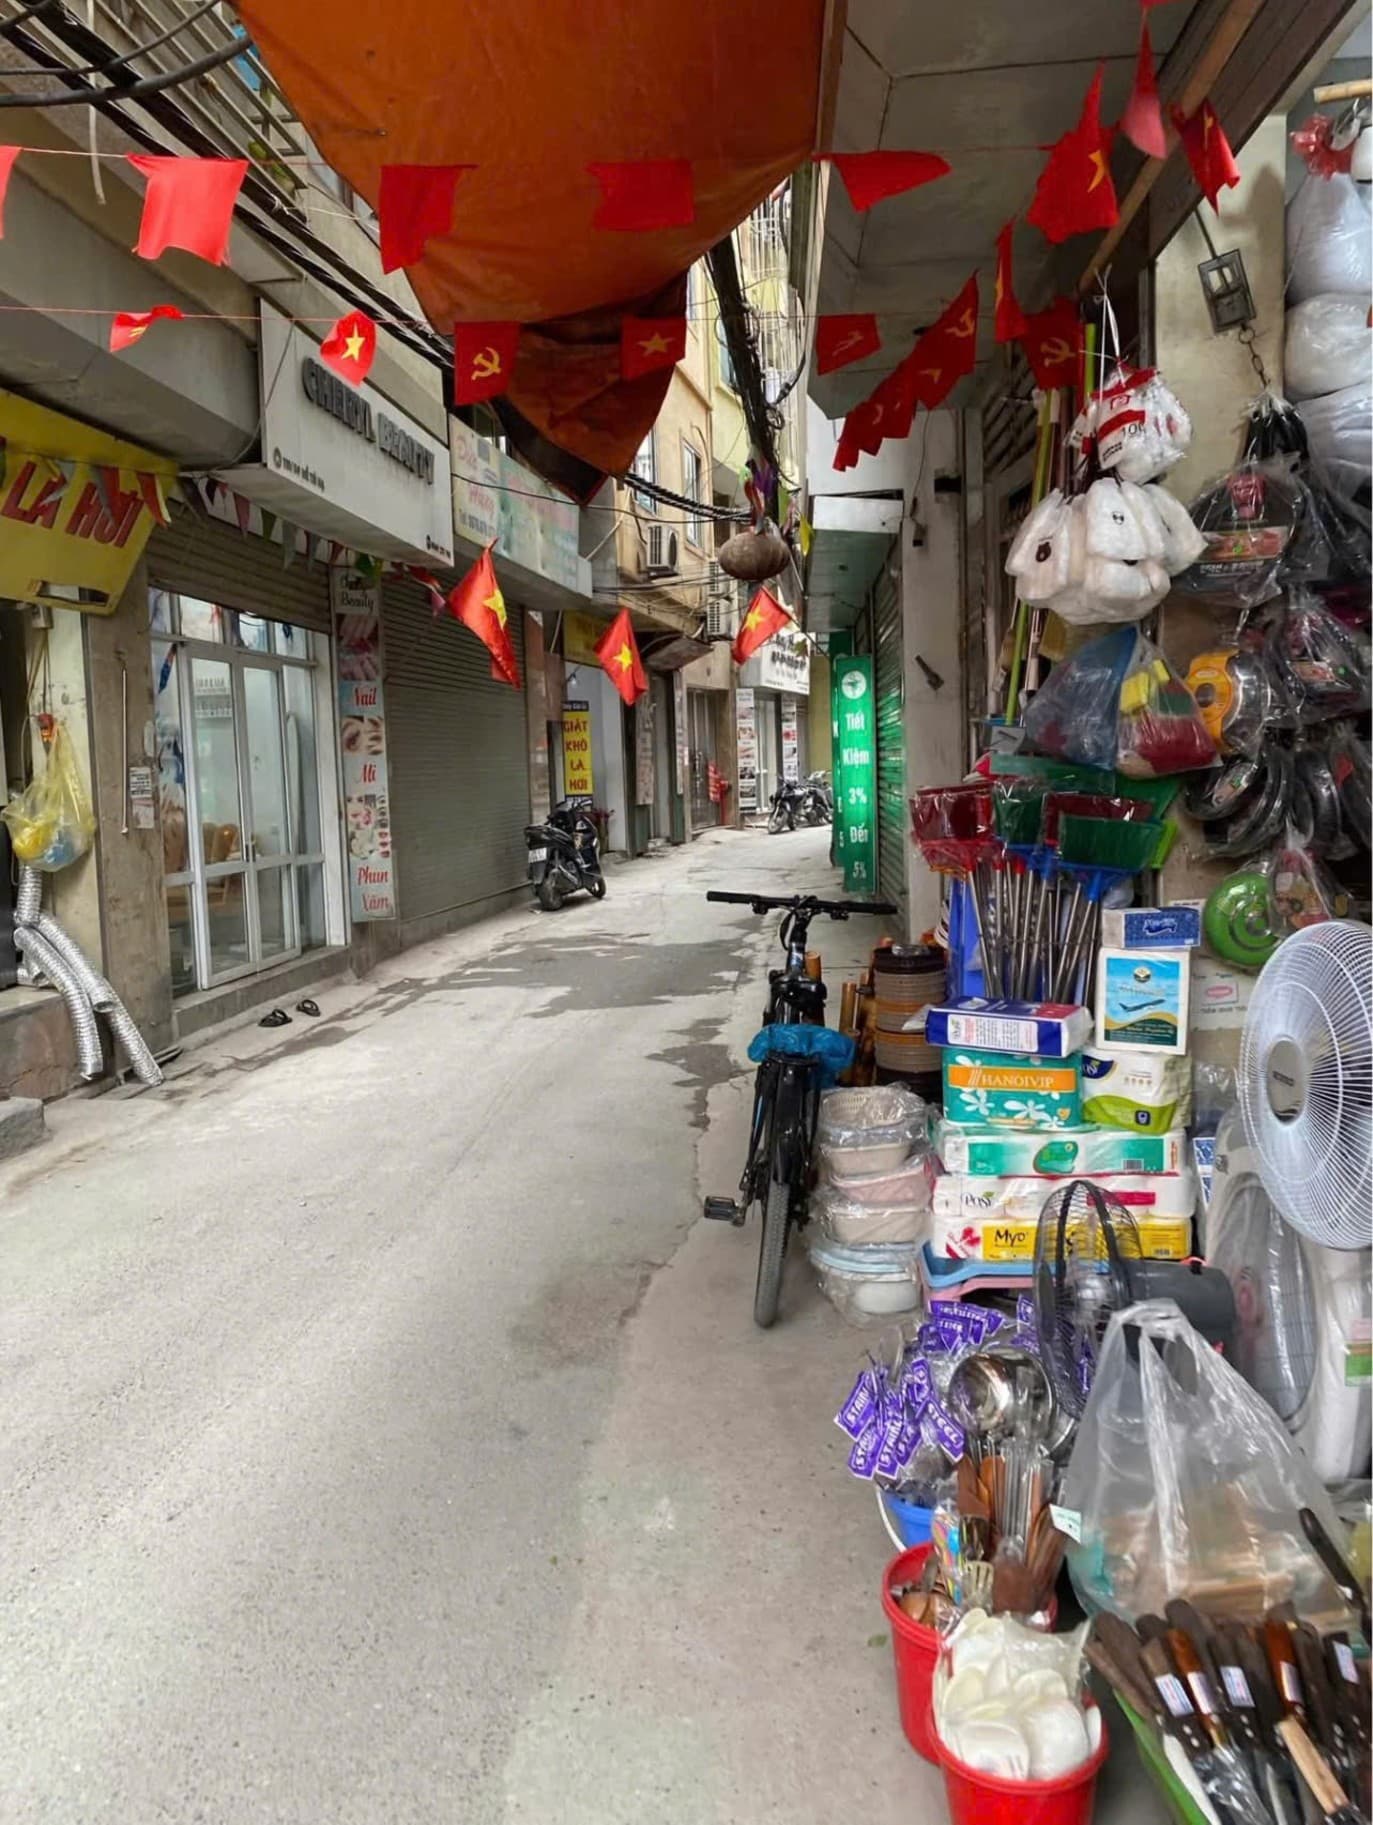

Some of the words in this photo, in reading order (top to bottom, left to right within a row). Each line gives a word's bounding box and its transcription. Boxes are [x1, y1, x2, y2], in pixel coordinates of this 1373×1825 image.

[845, 709, 866, 731] Tiết
[842, 747, 869, 769] Kiệm
[848, 787, 868, 804] 3%
[358, 866, 388, 886] Phun
